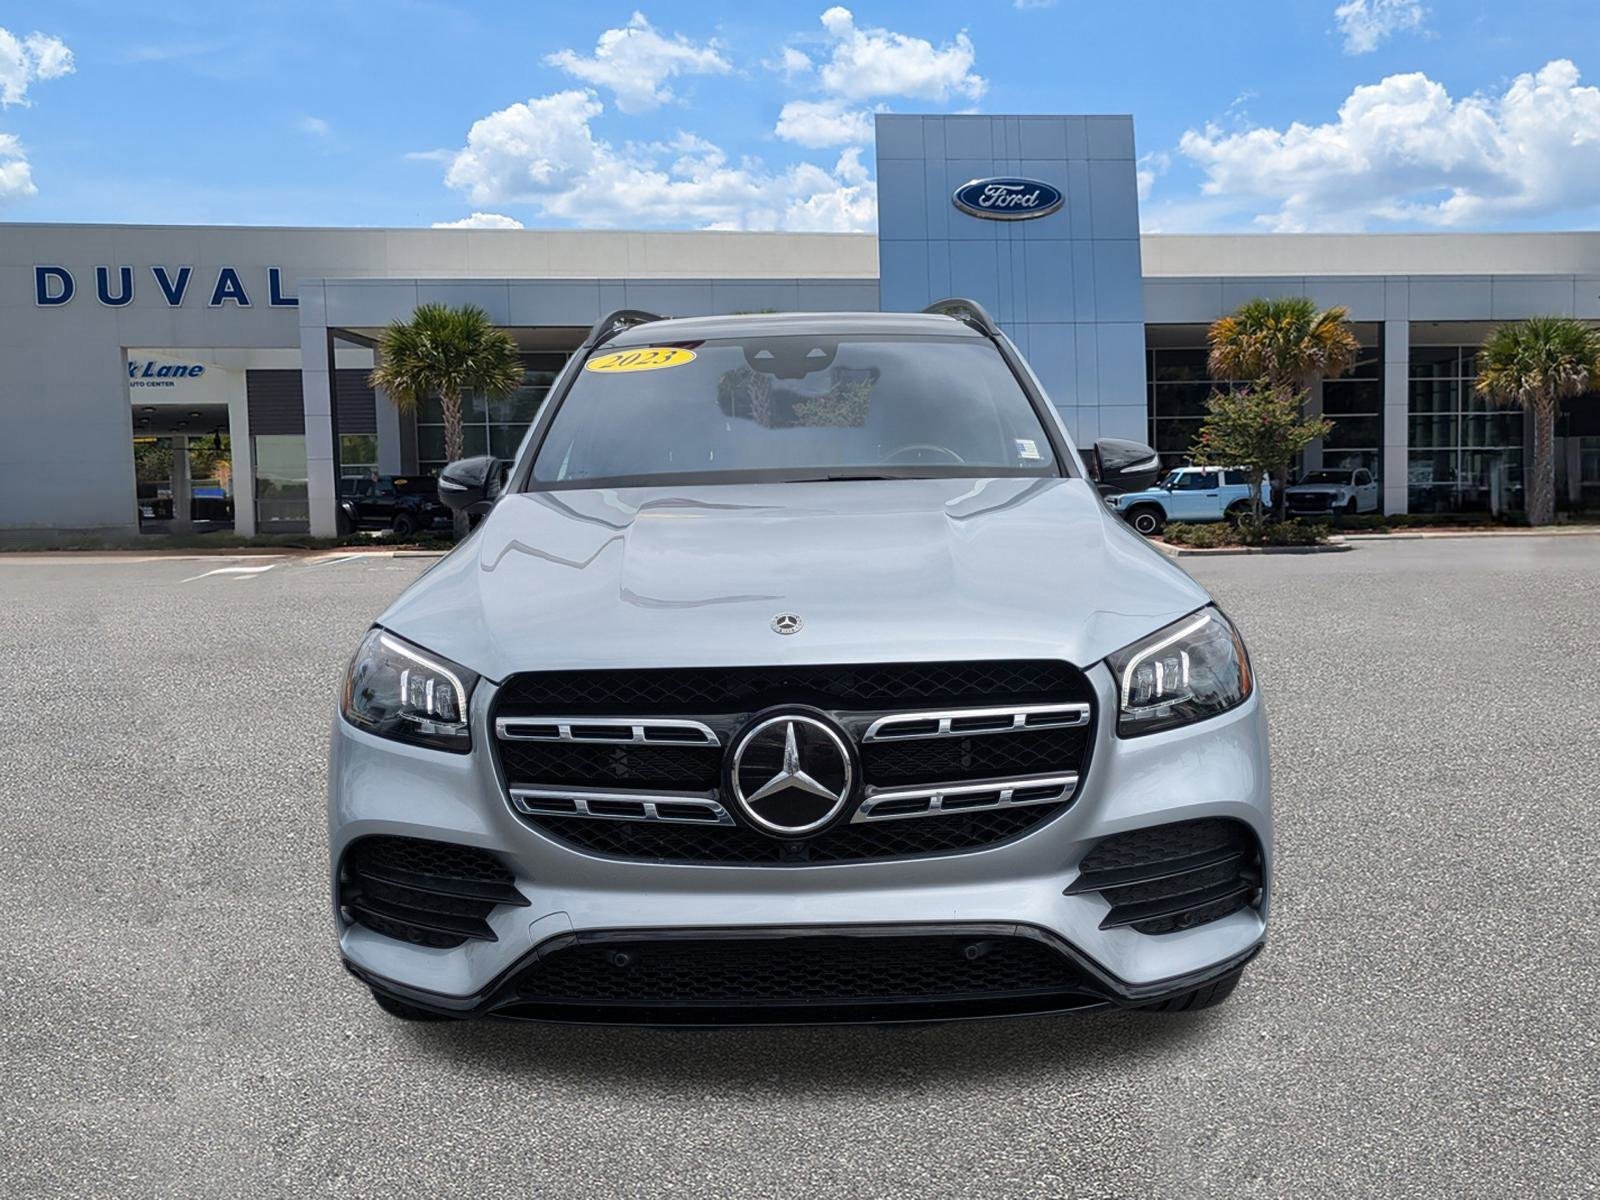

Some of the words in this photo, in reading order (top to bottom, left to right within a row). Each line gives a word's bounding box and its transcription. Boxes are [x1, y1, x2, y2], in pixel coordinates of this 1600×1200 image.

[979, 184, 1040, 207] Ford
[34, 266, 299, 307] DUVAL
[141, 361, 204, 378] Lane
[599, 350, 677, 369] 2023
